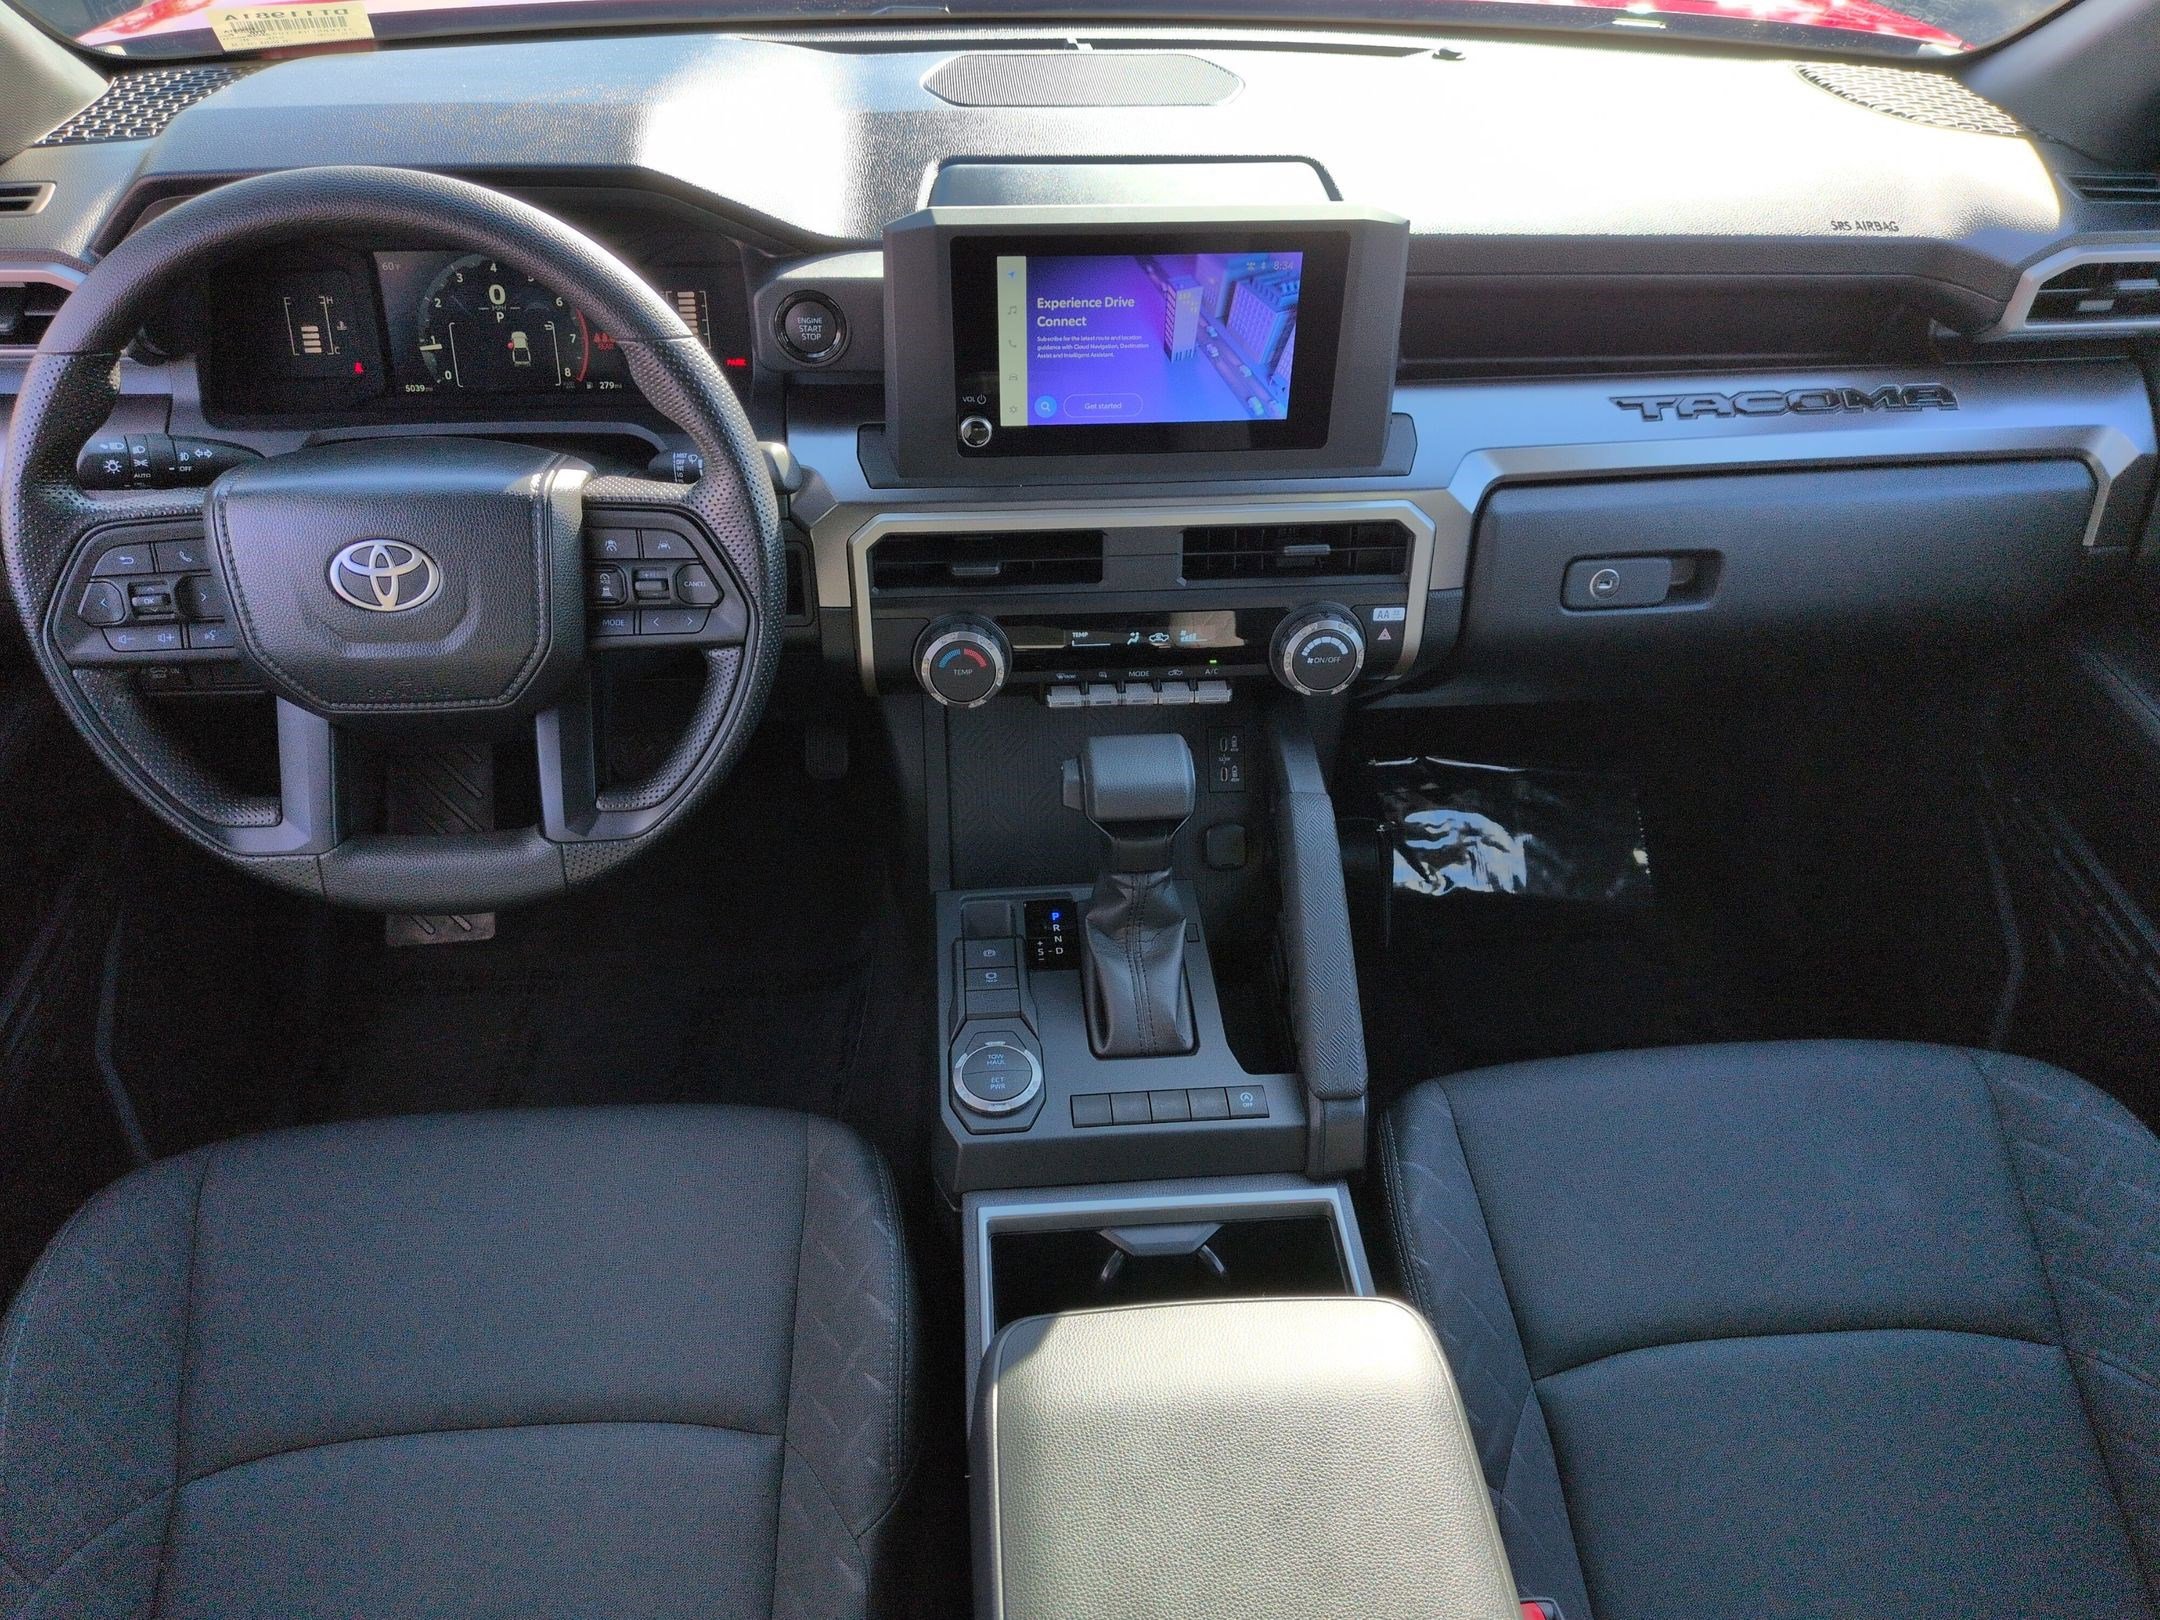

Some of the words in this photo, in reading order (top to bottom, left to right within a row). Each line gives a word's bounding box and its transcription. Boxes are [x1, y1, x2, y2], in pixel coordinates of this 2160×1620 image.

[1830, 220, 1852, 231] SRS
[1855, 221, 1900, 232] AIRBAG
[490, 262, 497, 272] 4
[456, 273, 464, 283] 3
[488, 284, 506, 305] 0
[434, 298, 442, 308] 2
[555, 297, 563, 307] 6
[1037, 297, 1102, 311] Experience
[1104, 296, 1135, 308] Drive
[496, 311, 504, 323] P
[1037, 316, 1088, 327] Connect
[799, 325, 823, 333] START
[569, 333, 576, 343] 7
[801, 333, 822, 341] STOP
[444, 370, 452, 380] 0
[564, 368, 572, 378] 8
[405, 384, 425, 393] 5039
[599, 380, 614, 390] 279
[962, 395, 976, 403] VOL
[1609, 382, 1960, 422] TACOMA
[1084, 402, 1097, 410] Get
[1314, 656, 1341, 664] ON/OFF
[953, 668, 973, 676] TEMP
[1128, 670, 1150, 678] MODE
[1204, 668, 1219, 676] A/C
[1051, 912, 1060, 921] P
[1052, 923, 1061, 932] R
[1054, 935, 1063, 943] N
[1037, 947, 1045, 956] S
[1055, 947, 1064, 955] D
